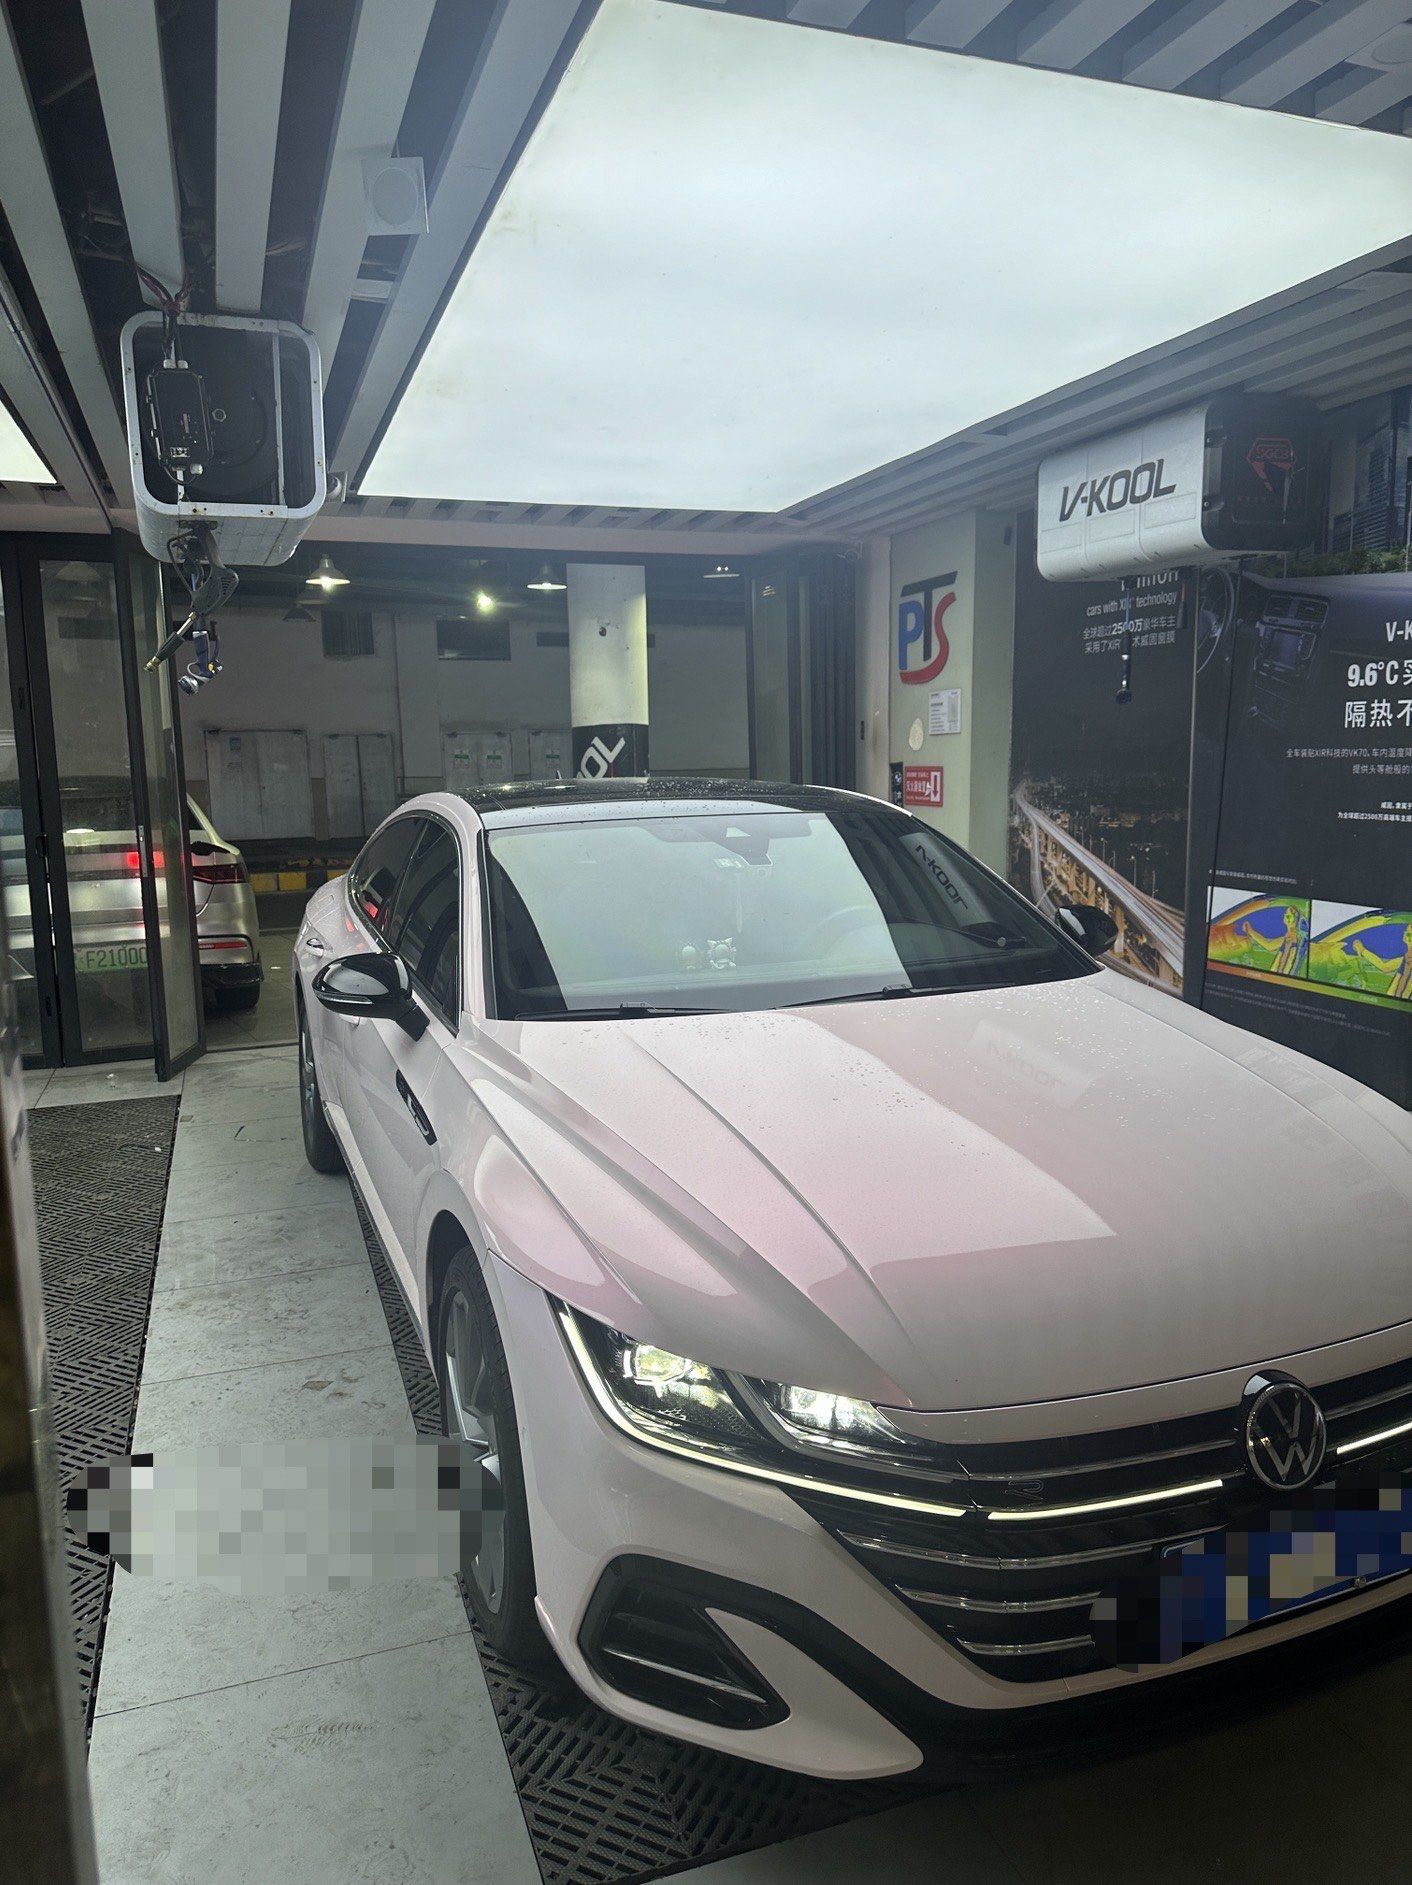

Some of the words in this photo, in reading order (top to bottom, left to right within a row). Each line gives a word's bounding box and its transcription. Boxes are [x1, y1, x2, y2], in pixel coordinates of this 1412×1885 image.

[1059, 459, 1177, 522] V-KOOL
[1086, 604, 1102, 617] cars
[1102, 601, 1118, 614] with
[1136, 591, 1177, 608] technology
[898, 571, 958, 685] PTS
[1344, 698, 1412, 728] 隔热不
